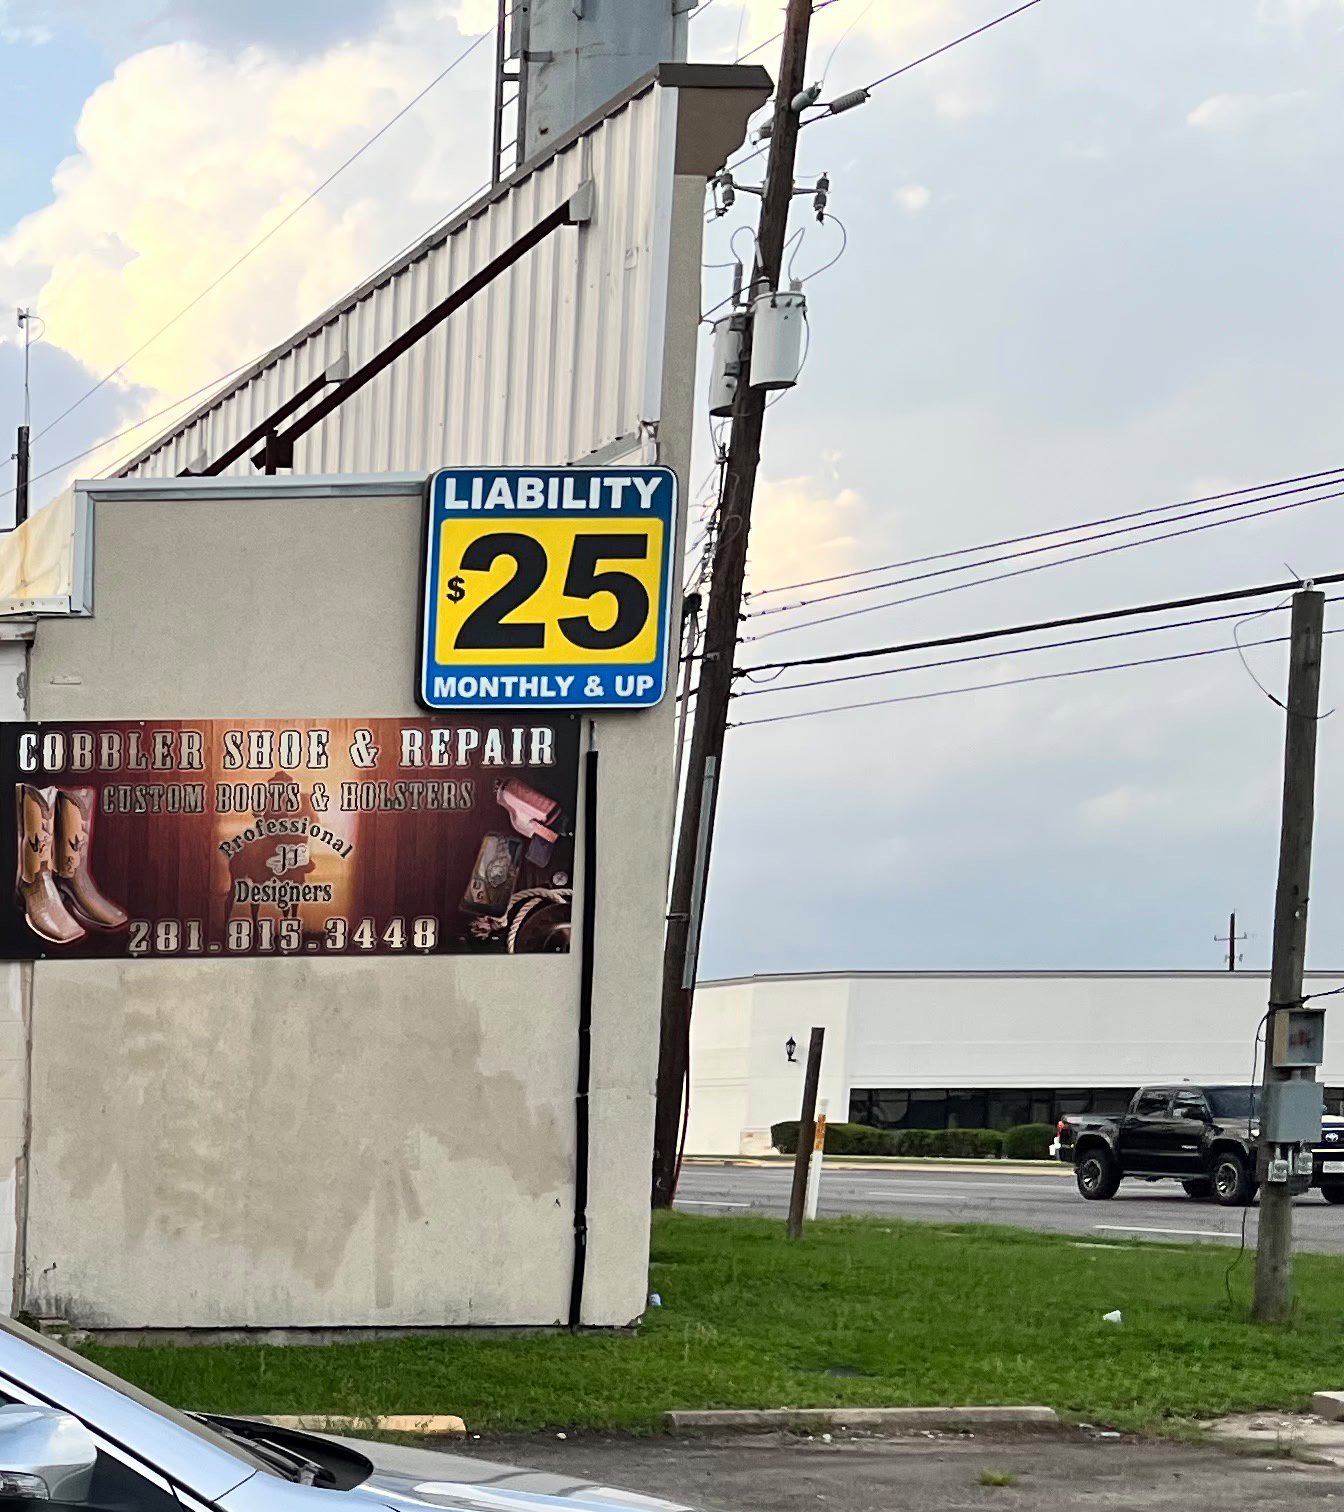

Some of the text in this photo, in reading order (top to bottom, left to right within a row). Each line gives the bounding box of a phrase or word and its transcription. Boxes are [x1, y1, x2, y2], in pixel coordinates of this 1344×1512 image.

[444, 477, 663, 510] LIABILITY
[433, 674, 655, 698] MONTHLY & UP
[18, 726, 555, 772] COBBLER SHOE & REPAIR
[102, 780, 475, 813] CUSTOM BOOTS & HOLSTERS
[218, 817, 353, 859] Professional
[236, 878, 332, 910] Designers
[128, 918, 438, 951] 281.815.3448
